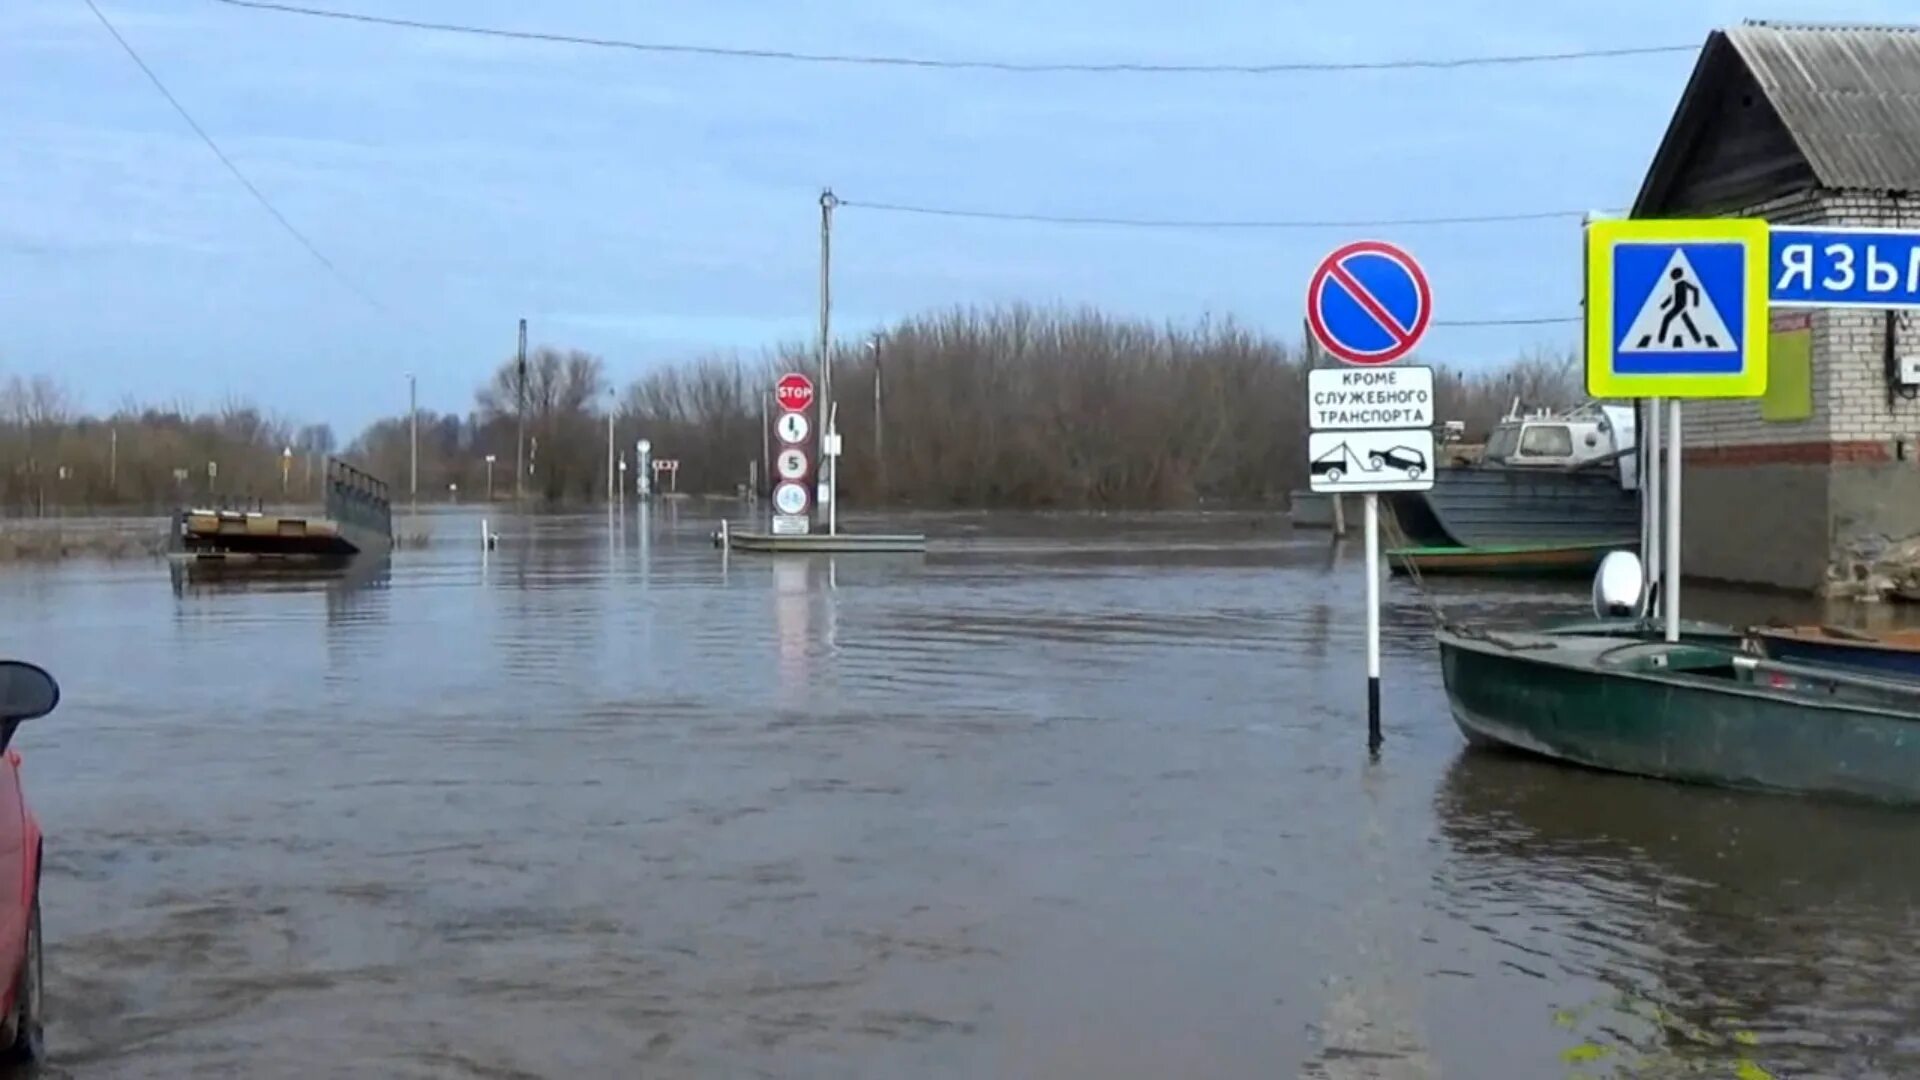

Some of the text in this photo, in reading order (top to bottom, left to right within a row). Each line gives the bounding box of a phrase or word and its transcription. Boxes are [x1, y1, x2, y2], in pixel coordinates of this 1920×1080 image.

[1342, 371, 1397, 386] КРОМЕ
[779, 386, 812, 398] STOP
[1314, 390, 1428, 405] СЛУЖЕБНОГО
[1319, 408, 1424, 423] ТРАНСПОРТА
[788, 456, 799, 471] 5
